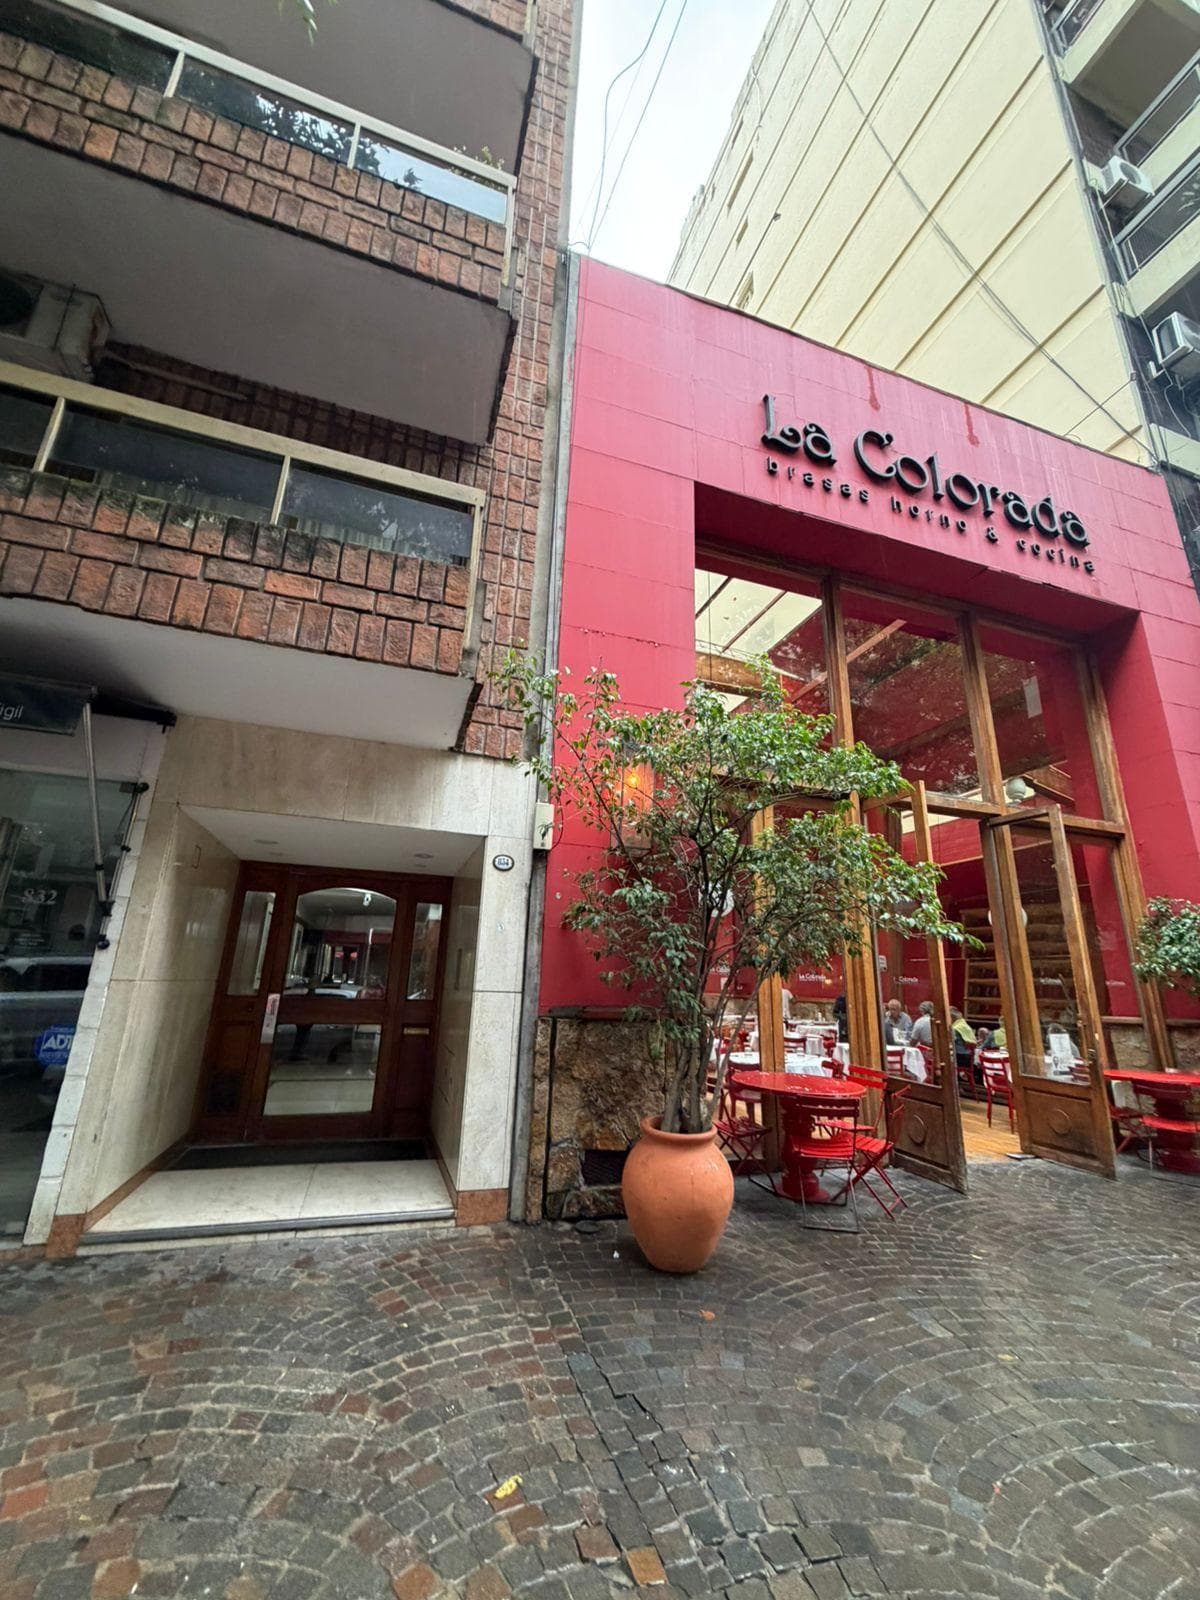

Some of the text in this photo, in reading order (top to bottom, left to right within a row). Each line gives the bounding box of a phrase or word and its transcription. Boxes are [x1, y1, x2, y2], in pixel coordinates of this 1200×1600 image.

[761, 394, 1092, 548] La Colorada
[766, 456, 1096, 575] brasas horno & cocina
[0, 702, 24, 720] igil
